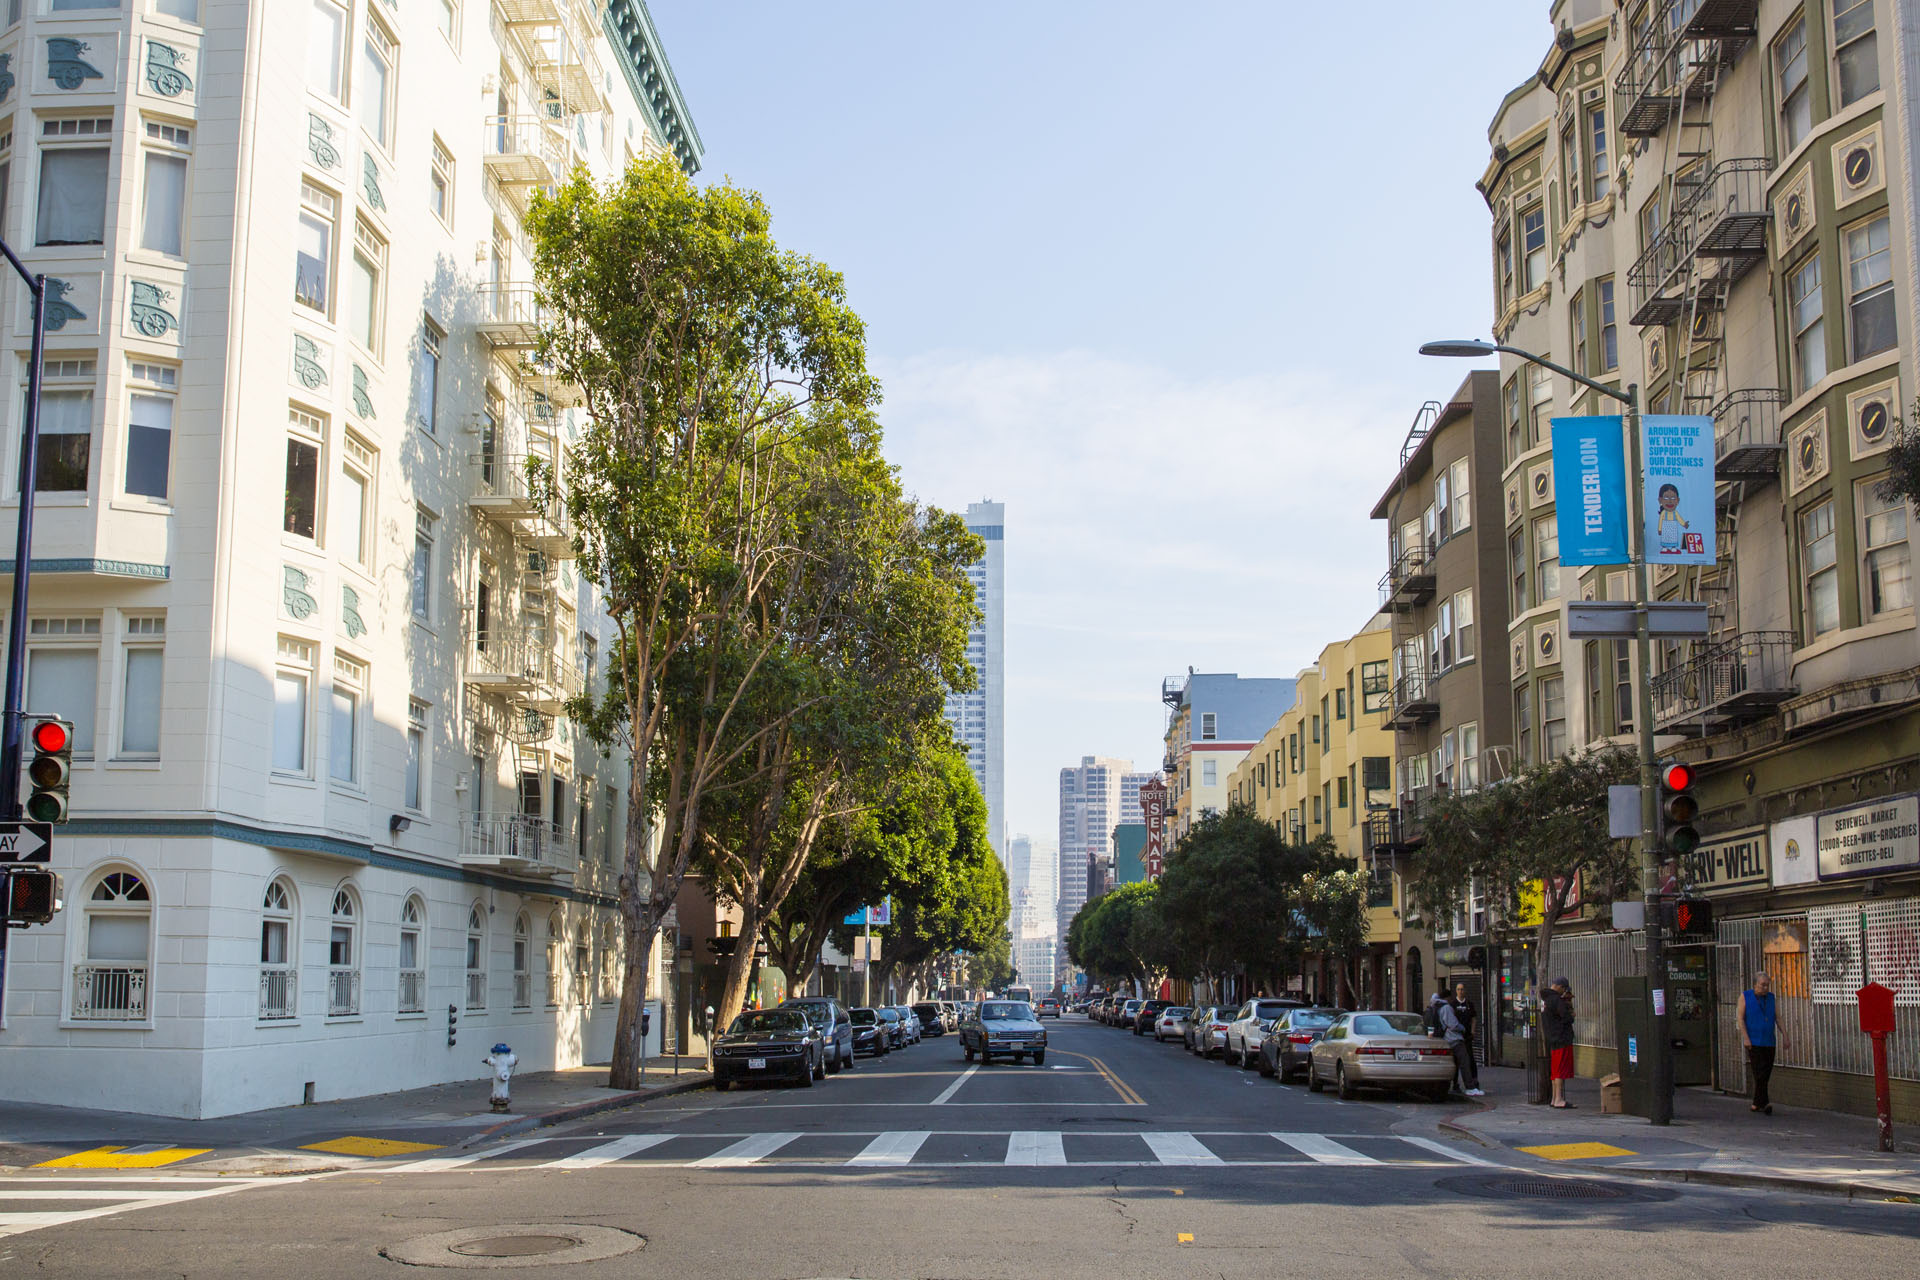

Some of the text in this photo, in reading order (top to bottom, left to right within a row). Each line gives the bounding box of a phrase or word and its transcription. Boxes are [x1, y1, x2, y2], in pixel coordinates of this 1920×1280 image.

[1648, 427, 1700, 437] AROUND HERE
[1649, 437, 1694, 447] WE TEND TO
[1649, 447, 1684, 456] SUPPORT
[1649, 457, 1704, 467] OUR BUSINESS
[1650, 467, 1684, 477] OWNERS.
[1580, 438, 1603, 536] TENDERLOIN
[1835, 808, 1897, 831] SERVEWELL MARKET
[1669, 972, 1697, 980] CORONA
